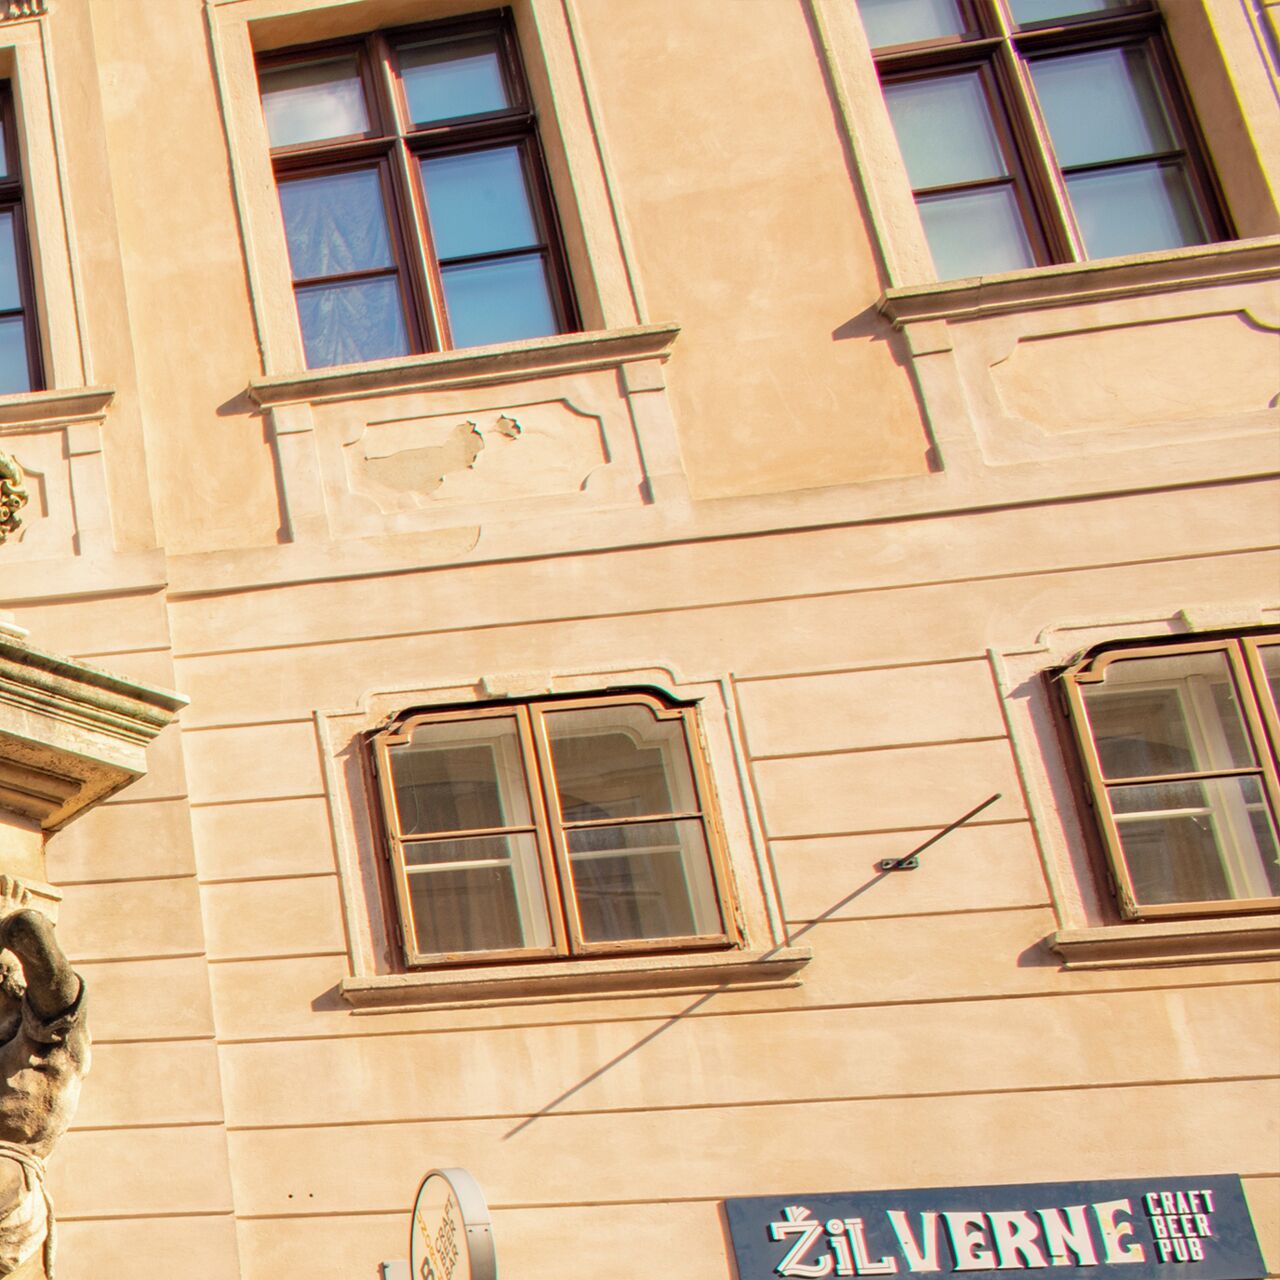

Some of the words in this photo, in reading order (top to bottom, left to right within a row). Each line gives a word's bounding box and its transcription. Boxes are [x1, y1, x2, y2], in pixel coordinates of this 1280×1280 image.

[1145, 1190, 1215, 1216] CRAFT
[887, 1198, 1144, 1272] VERNE
[1151, 1215, 1213, 1240] BEER
[1158, 1238, 1206, 1263] PUB
